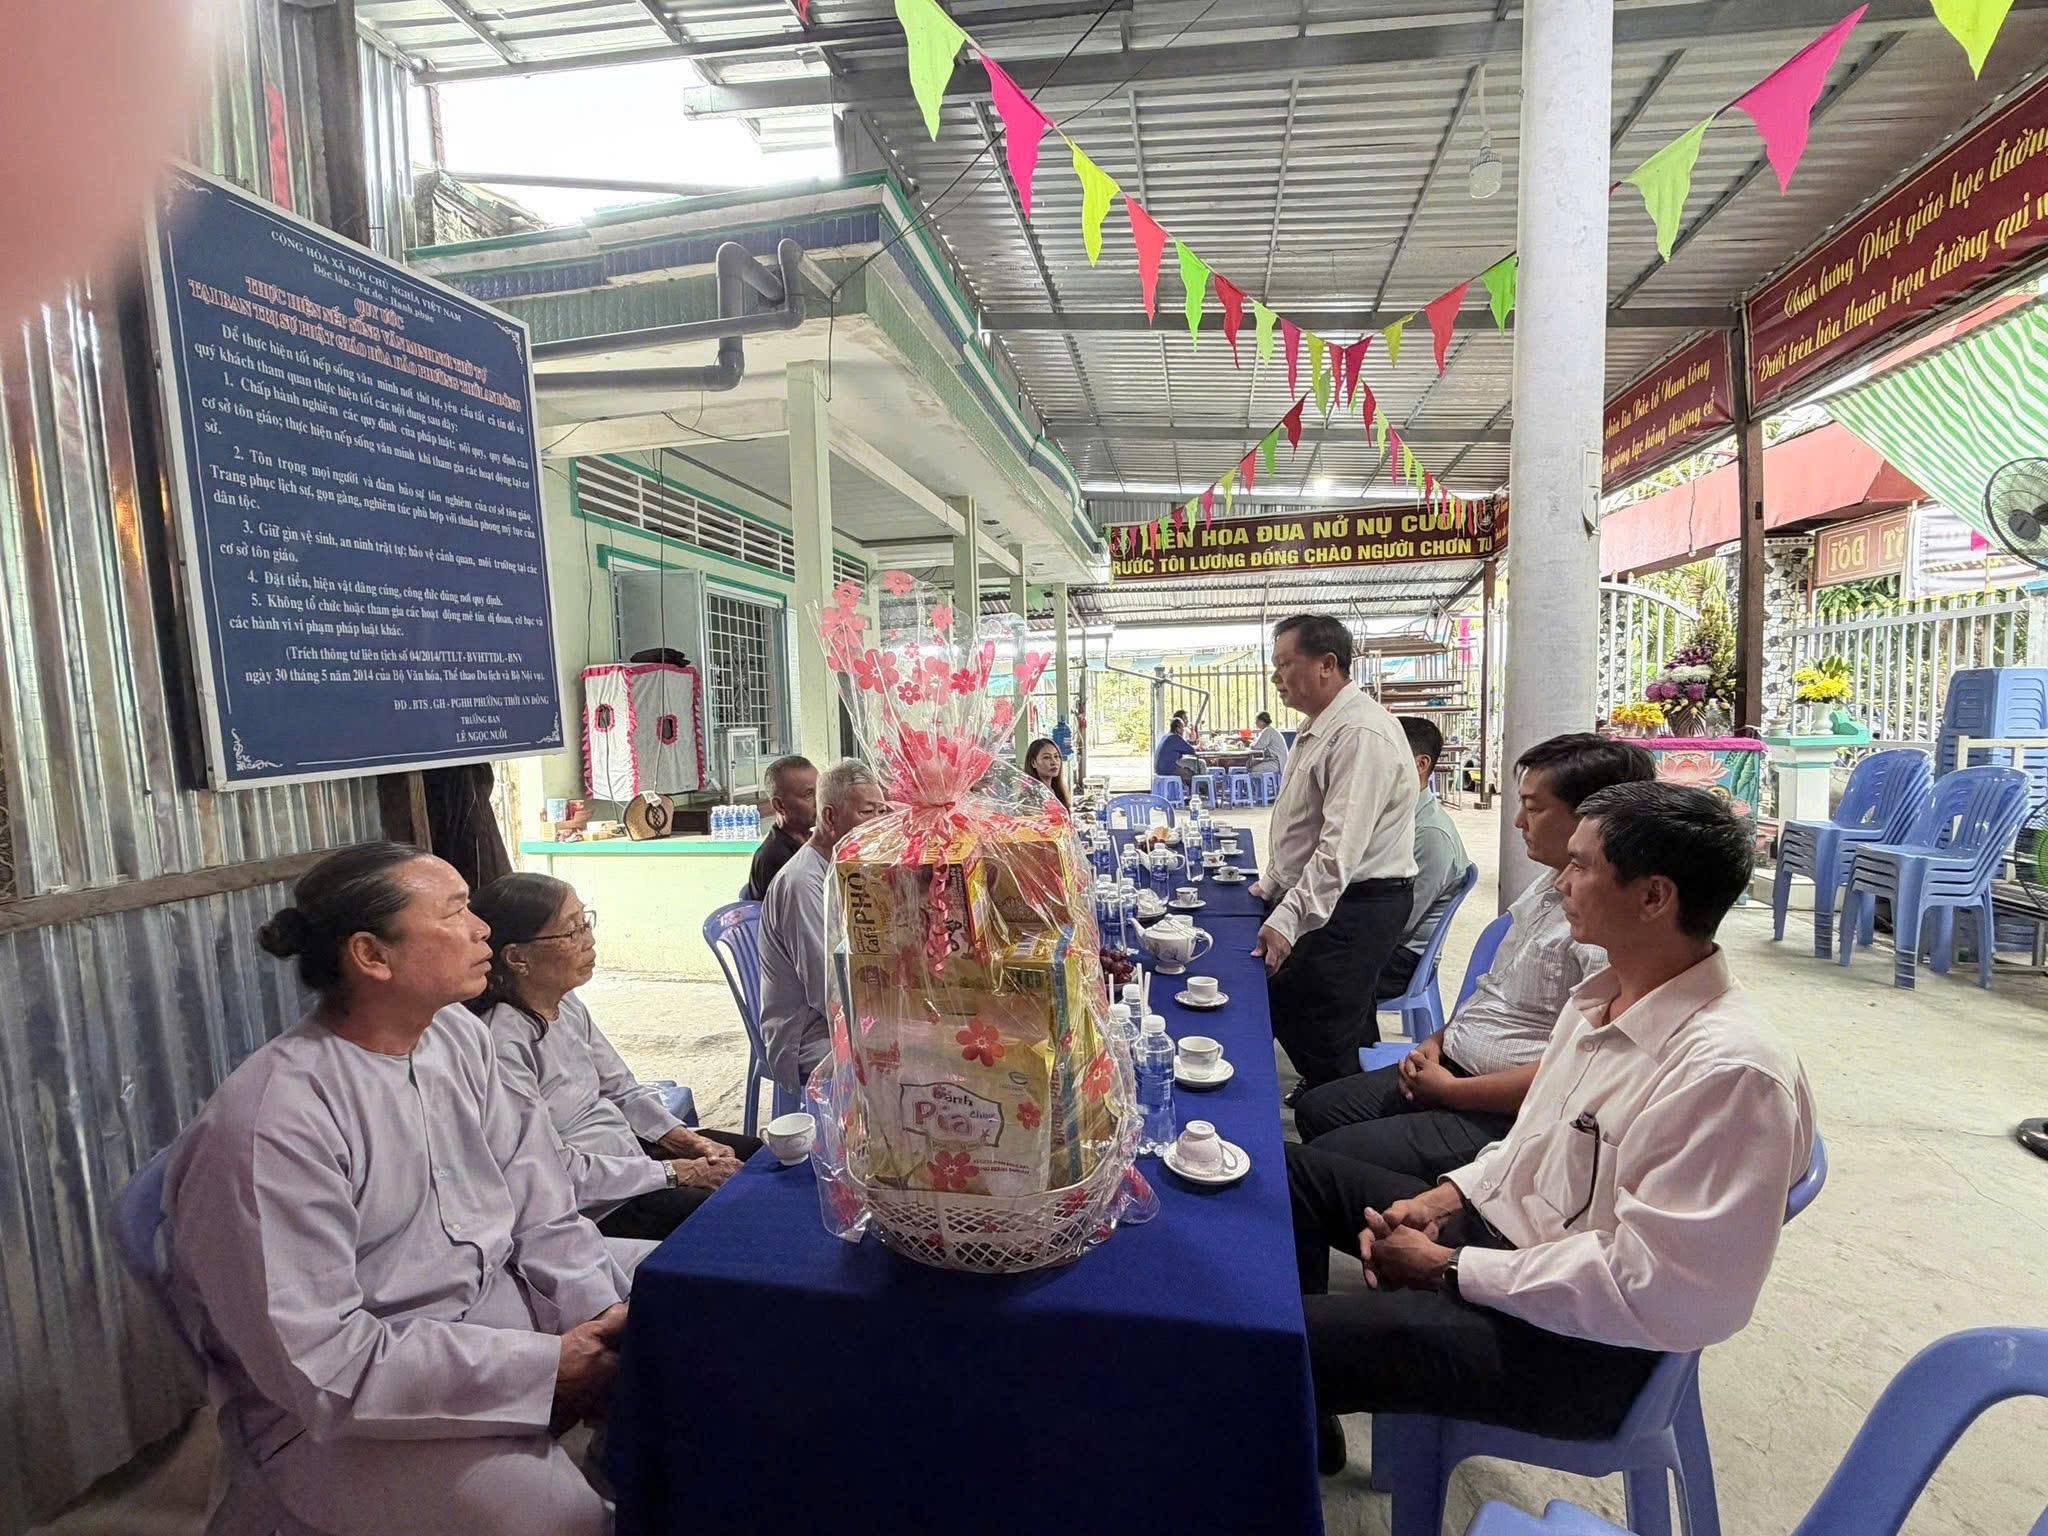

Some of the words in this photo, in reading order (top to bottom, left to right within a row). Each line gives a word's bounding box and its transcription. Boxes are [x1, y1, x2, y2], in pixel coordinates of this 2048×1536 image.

[1784, 277, 1818, 318] Chấn
[1820, 257, 1854, 297] hưng
[1858, 216, 1901, 275] Phật
[1906, 191, 1944, 244] giáo
[1950, 171, 1985, 209] học
[1789, 334, 1813, 366] trên
[1816, 317, 1842, 350] hòa
[1844, 289, 1888, 333] thuận
[1891, 268, 1925, 305] trọn
[1930, 229, 1990, 282] đường
[1994, 192, 2031, 250] qui
[213, 489, 236, 505] dân
[238, 494, 260, 510] tộc.
[1201, 527, 1250, 547] HOA
[1256, 522, 1306, 543] ĐUA
[1313, 514, 1350, 539] NỞ
[1356, 516, 1393, 538] NỤ
[219, 542, 234, 555] cơ
[236, 541, 249, 557] sở
[251, 545, 270, 559] tôn
[272, 547, 299, 563] giáo.
[1159, 555, 1185, 573] TÔI
[1190, 551, 1246, 571] LƯƠNG
[1304, 542, 1353, 563] CHÀO
[1357, 539, 1415, 560] NGƯỜI
[1420, 536, 1473, 556] CHƠN
